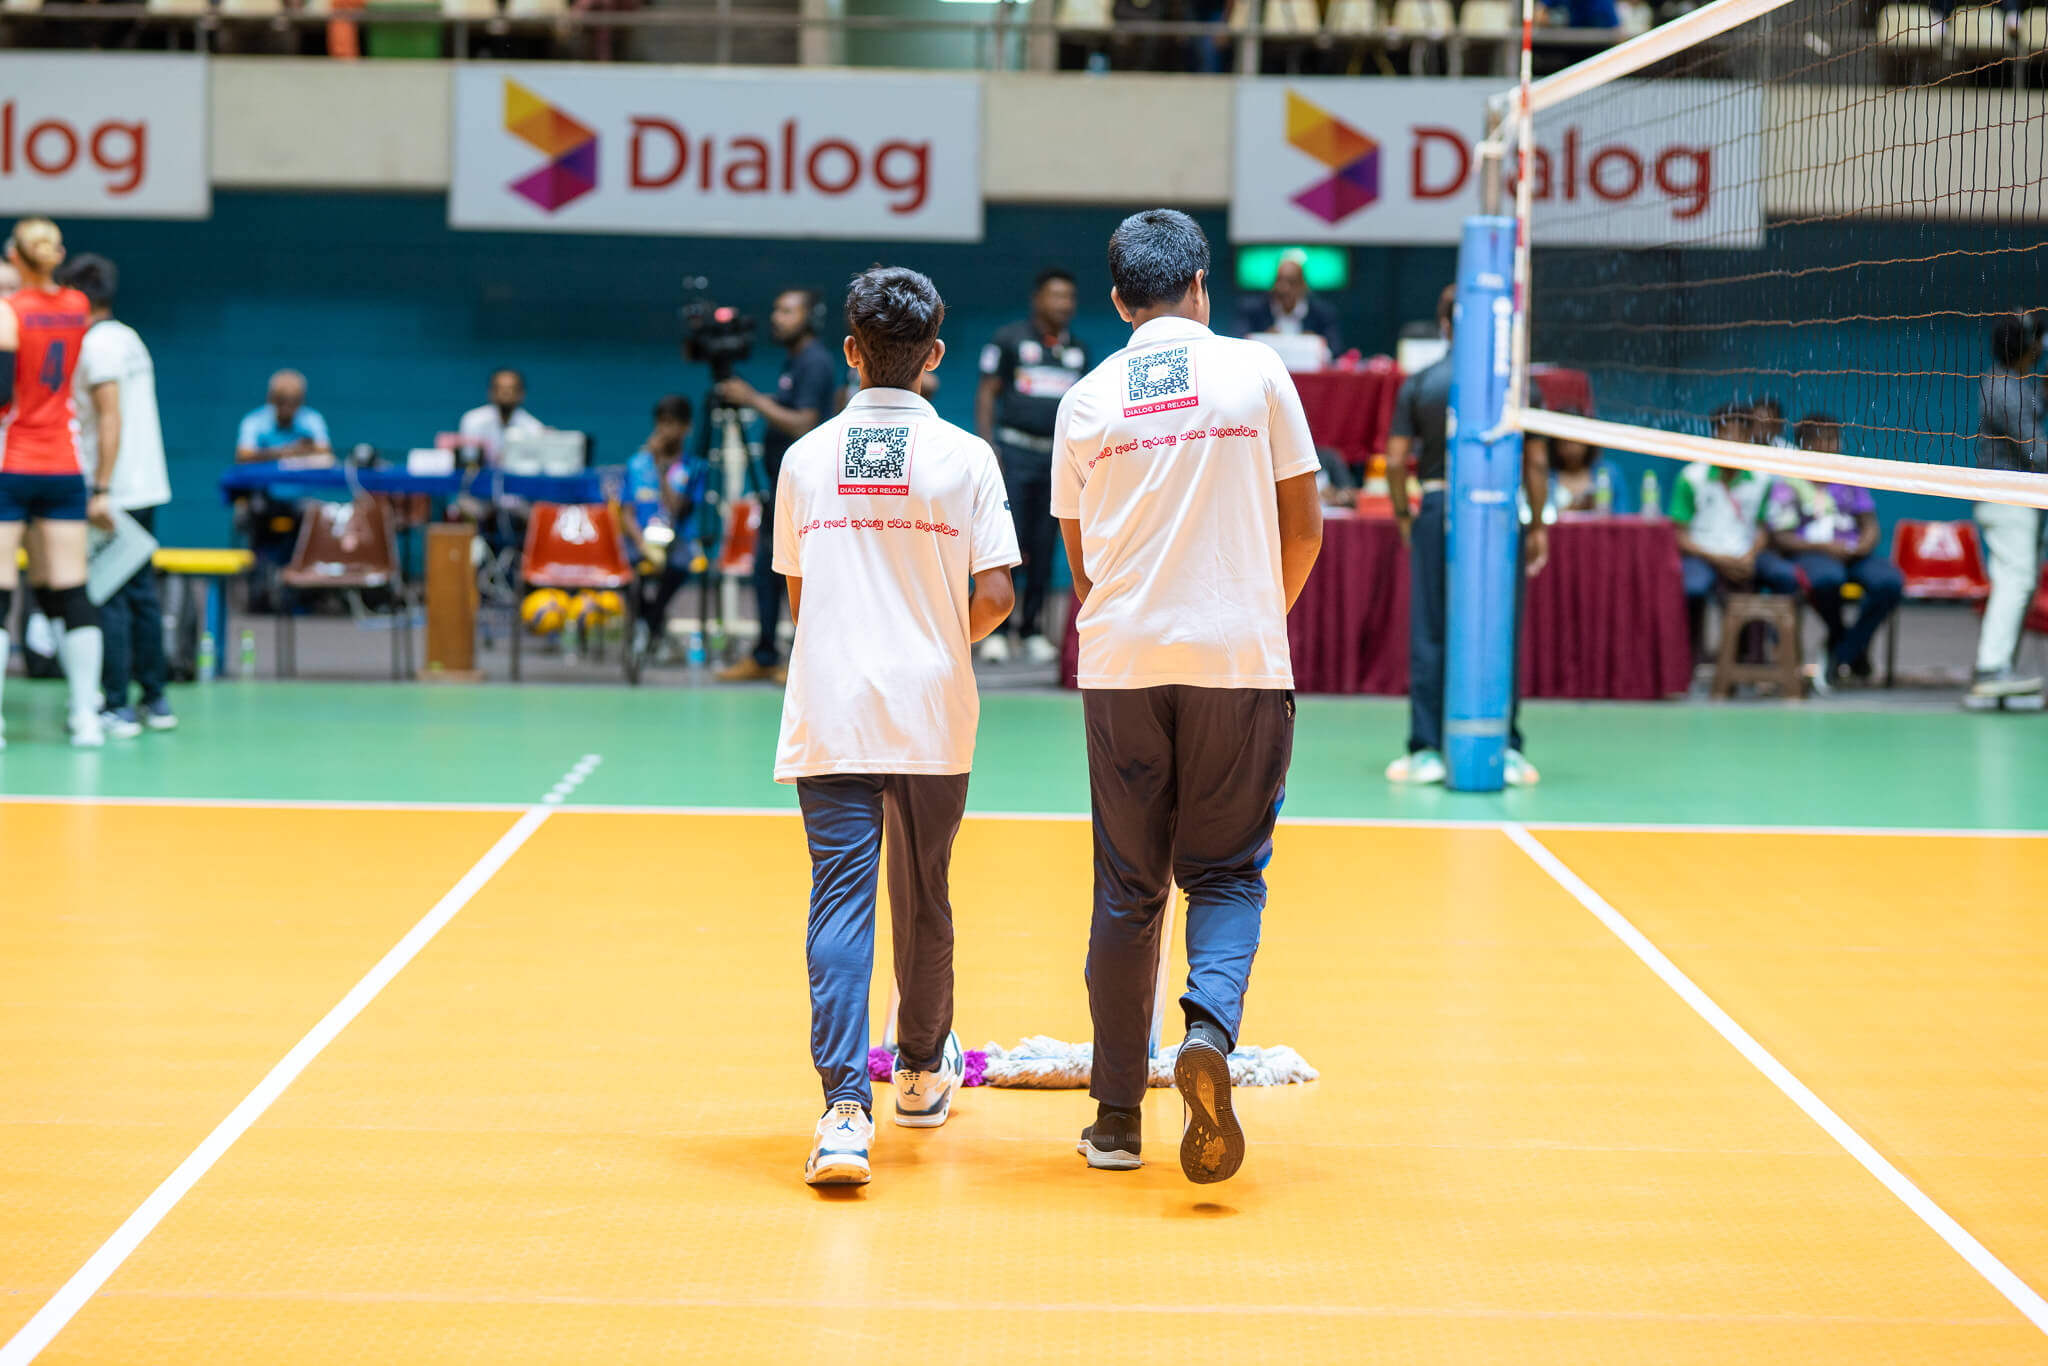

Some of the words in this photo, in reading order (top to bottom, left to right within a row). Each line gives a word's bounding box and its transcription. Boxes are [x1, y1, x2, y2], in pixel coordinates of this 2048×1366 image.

[0, 102, 147, 197] log
[628, 117, 931, 215] Dialog
[1410, 125, 1712, 219] Dalog
[39, 339, 65, 393] 4
[1125, 406, 1153, 416] DIALOG
[1167, 399, 1197, 408] RELOAD
